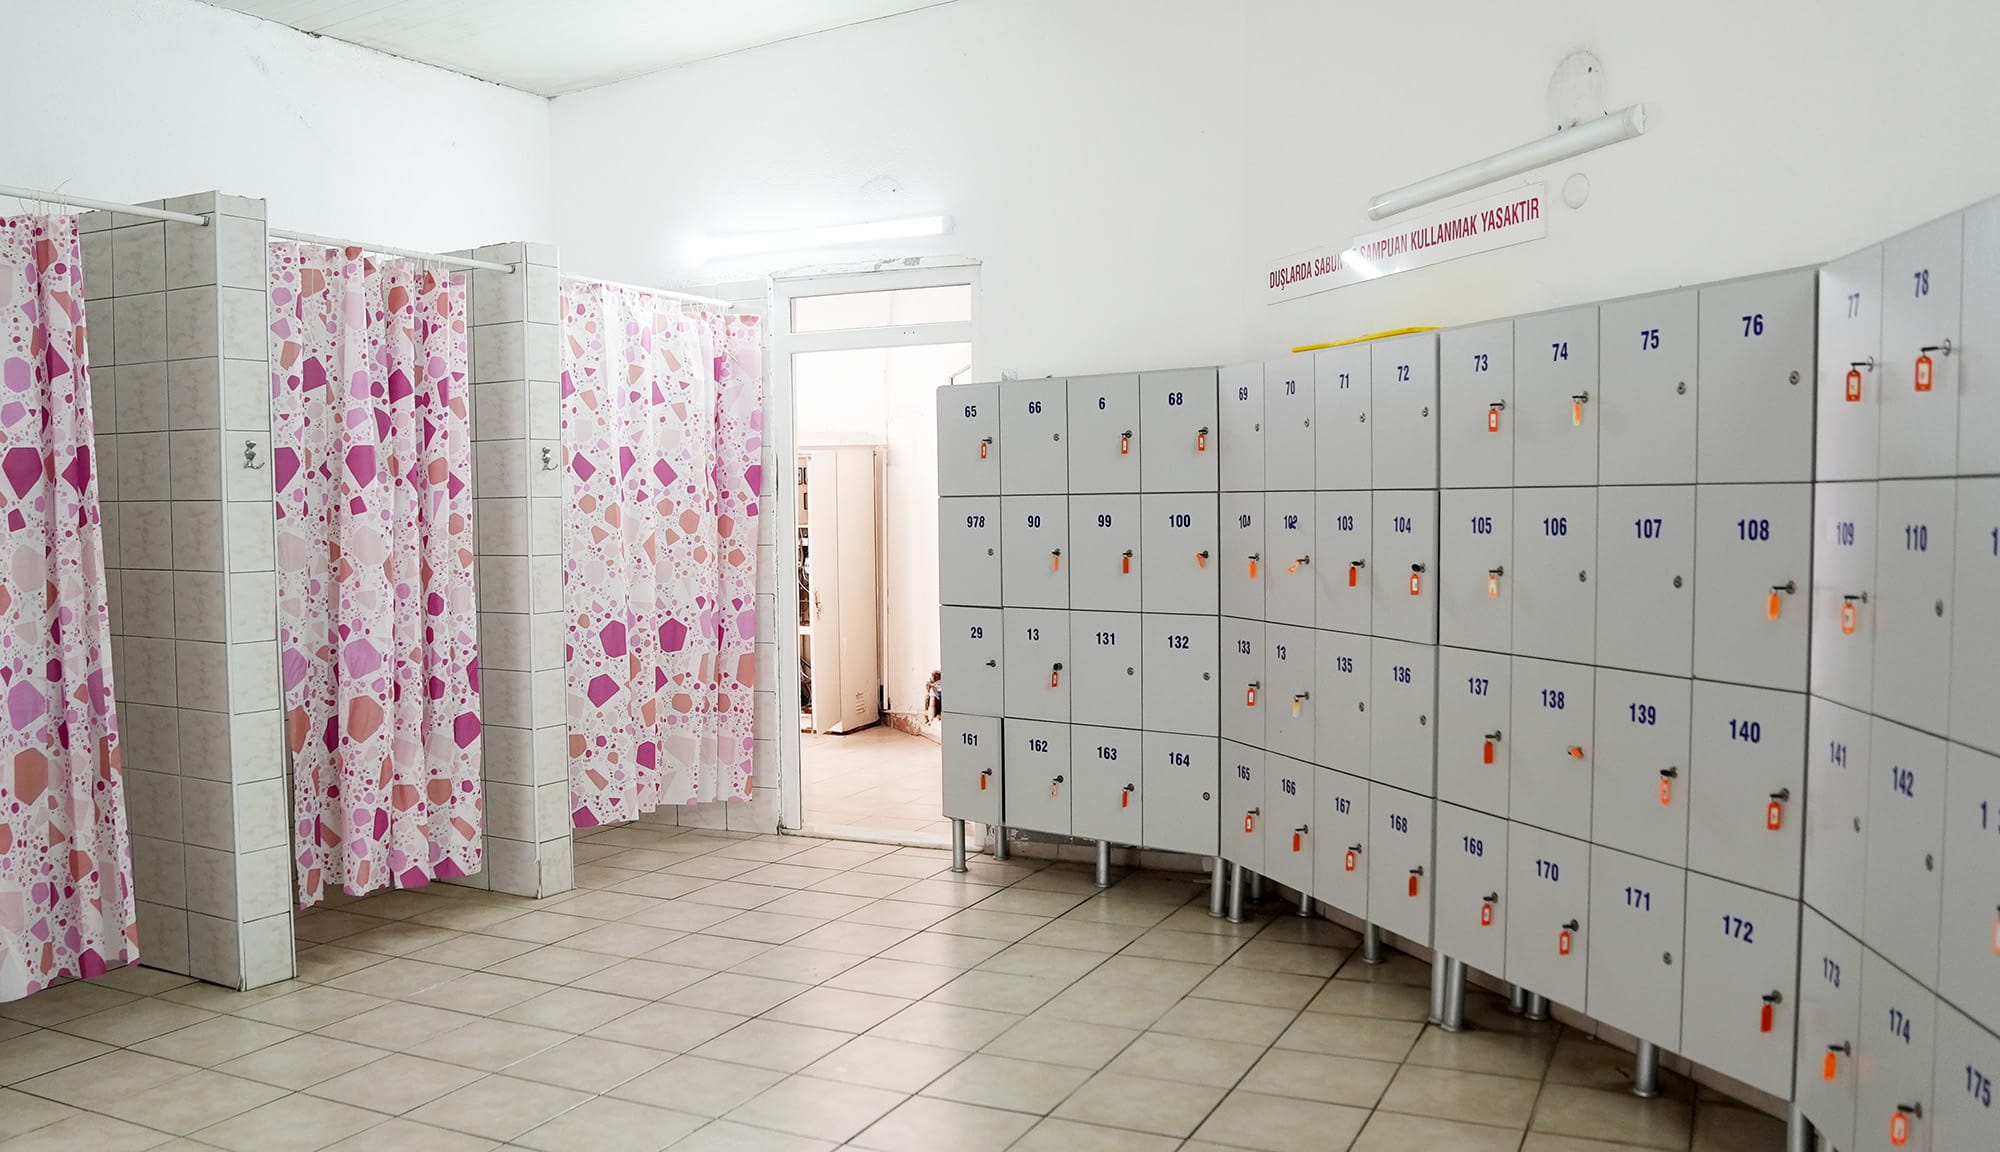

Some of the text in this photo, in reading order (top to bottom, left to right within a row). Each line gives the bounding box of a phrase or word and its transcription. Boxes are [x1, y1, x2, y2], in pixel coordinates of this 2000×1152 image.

[1269, 261, 1313, 291] DUŞLARDA
[1314, 254, 1343, 276] SABUN
[1410, 214, 1478, 250] KULLANMAK
[1481, 197, 1540, 233] YASAKTIR
[1914, 269, 1929, 298] 78
[1742, 313, 1764, 338] 76
[1640, 328, 1660, 351] 75
[1551, 341, 1569, 362] 74
[1474, 353, 1488, 373] 73
[1339, 373, 1350, 389] 71
[1397, 364, 1410, 382] 72
[1238, 386, 1248, 401] 69
[1285, 380, 1296, 396] 70
[1028, 400, 1042, 415] 66
[1098, 396, 1106, 410] 6
[1168, 391, 1183, 406] 68
[964, 405, 977, 418] 65
[966, 515, 986, 528] 978
[1027, 515, 1041, 529] 90
[1097, 514, 1112, 528] 99
[1168, 514, 1191, 528] 100
[1336, 515, 1354, 532] 103
[1393, 516, 1412, 534] 104
[1471, 516, 1492, 535] 105
[1543, 517, 1567, 537] 106
[1634, 518, 1663, 539] 107
[1737, 519, 1770, 541] 108
[1837, 522, 1855, 546] 109
[1905, 525, 1928, 552] 110
[970, 626, 983, 639] 29
[1026, 627, 1040, 641] 13
[1095, 631, 1115, 646] 131
[1167, 635, 1190, 650] 132
[1237, 639, 1251, 655] 133
[1276, 644, 1287, 661] 13
[1336, 656, 1353, 674] 135
[1392, 665, 1411, 684] 136
[1468, 677, 1489, 697] 137
[1541, 688, 1565, 710] 138
[1629, 703, 1656, 726] 139
[962, 732, 978, 747] 161
[1729, 719, 1761, 744] 140
[1028, 738, 1048, 753] 162
[1096, 745, 1118, 761] 163
[1830, 741, 1847, 769] 141
[1168, 751, 1191, 768] 164
[1237, 764, 1251, 781] 165
[1892, 766, 1914, 798] 142
[1281, 778, 1296, 796] 166
[1335, 796, 1351, 815] 167
[1390, 813, 1408, 834] 168
[1463, 835, 1483, 857] 169
[1535, 859, 1559, 882] 170
[1625, 886, 1650, 912] 171
[1722, 914, 1754, 944] 172
[1823, 957, 1841, 988] 173
[1889, 1007, 1911, 1044] 174
[1965, 1065, 1991, 1108] 175
